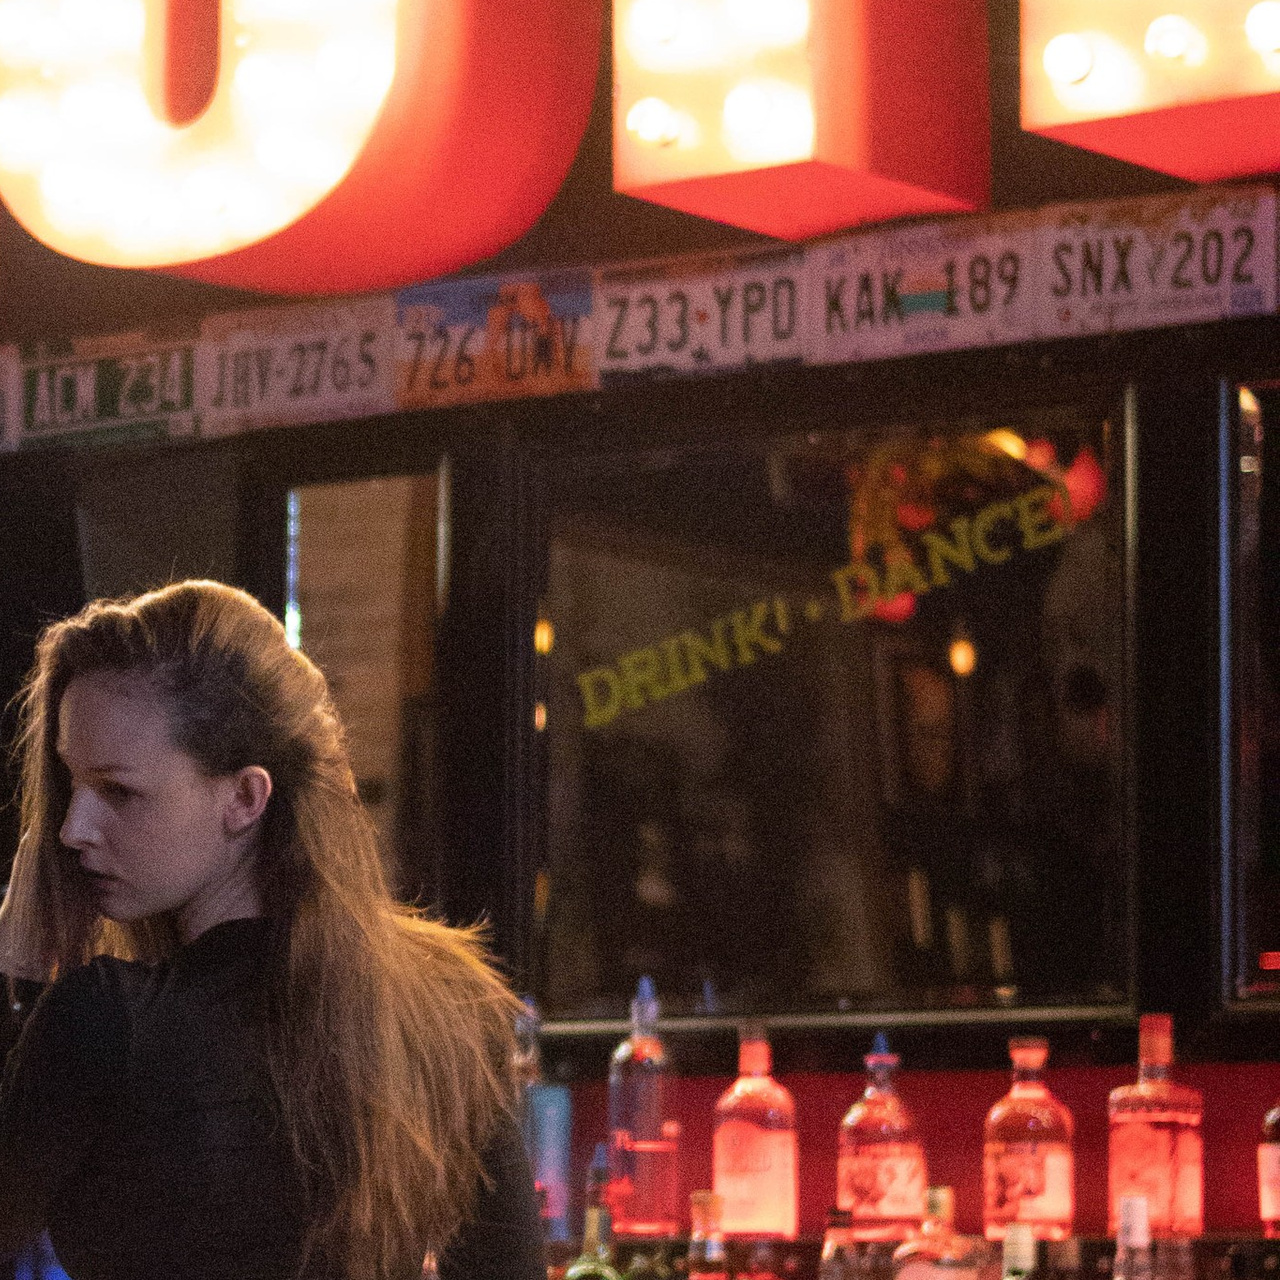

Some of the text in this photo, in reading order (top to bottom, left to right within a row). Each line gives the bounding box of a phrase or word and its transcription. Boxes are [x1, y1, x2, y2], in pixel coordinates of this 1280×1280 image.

[824, 250, 1020, 335] KAK 189
[1052, 224, 1255, 297] SNX 202
